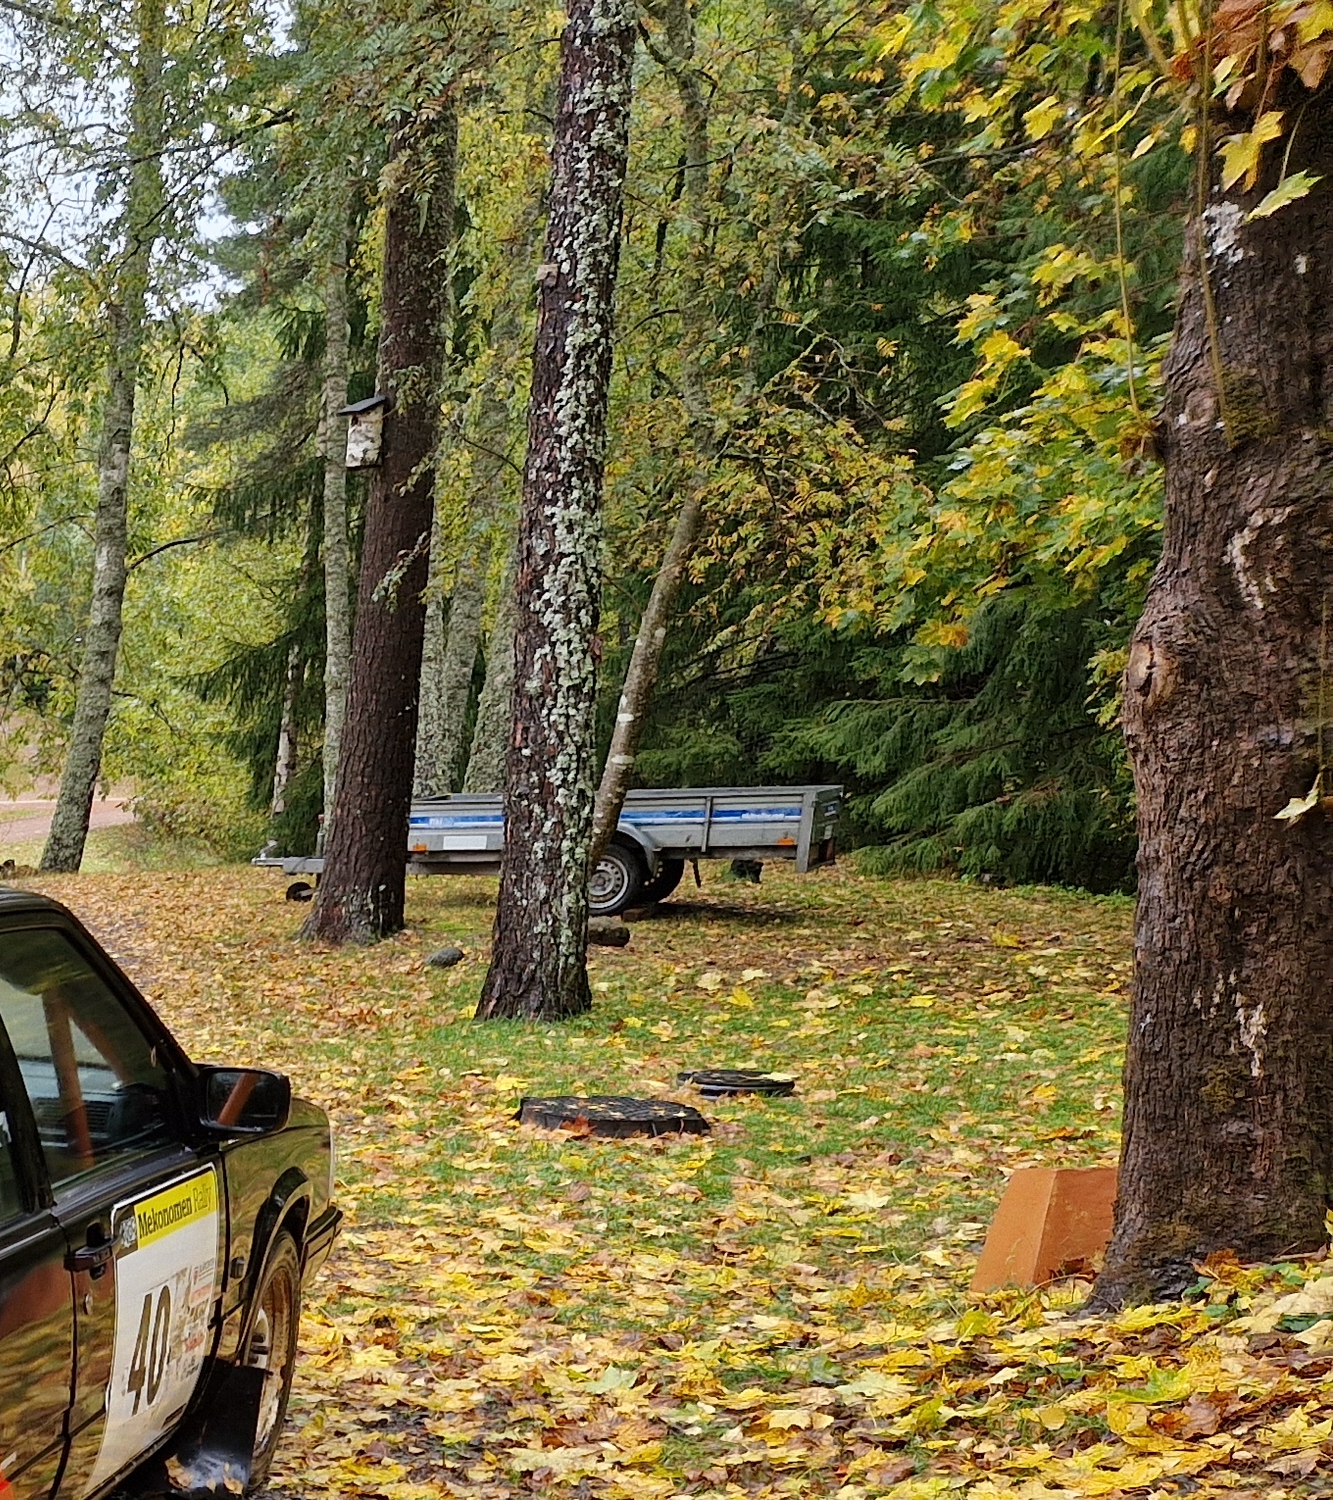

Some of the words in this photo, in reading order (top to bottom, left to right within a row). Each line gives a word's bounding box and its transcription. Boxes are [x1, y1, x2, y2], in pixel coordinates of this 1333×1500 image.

[137, 1196, 193, 1239] Mekonomen
[192, 1182, 212, 1213] Rally
[127, 1284, 172, 1416] 40
